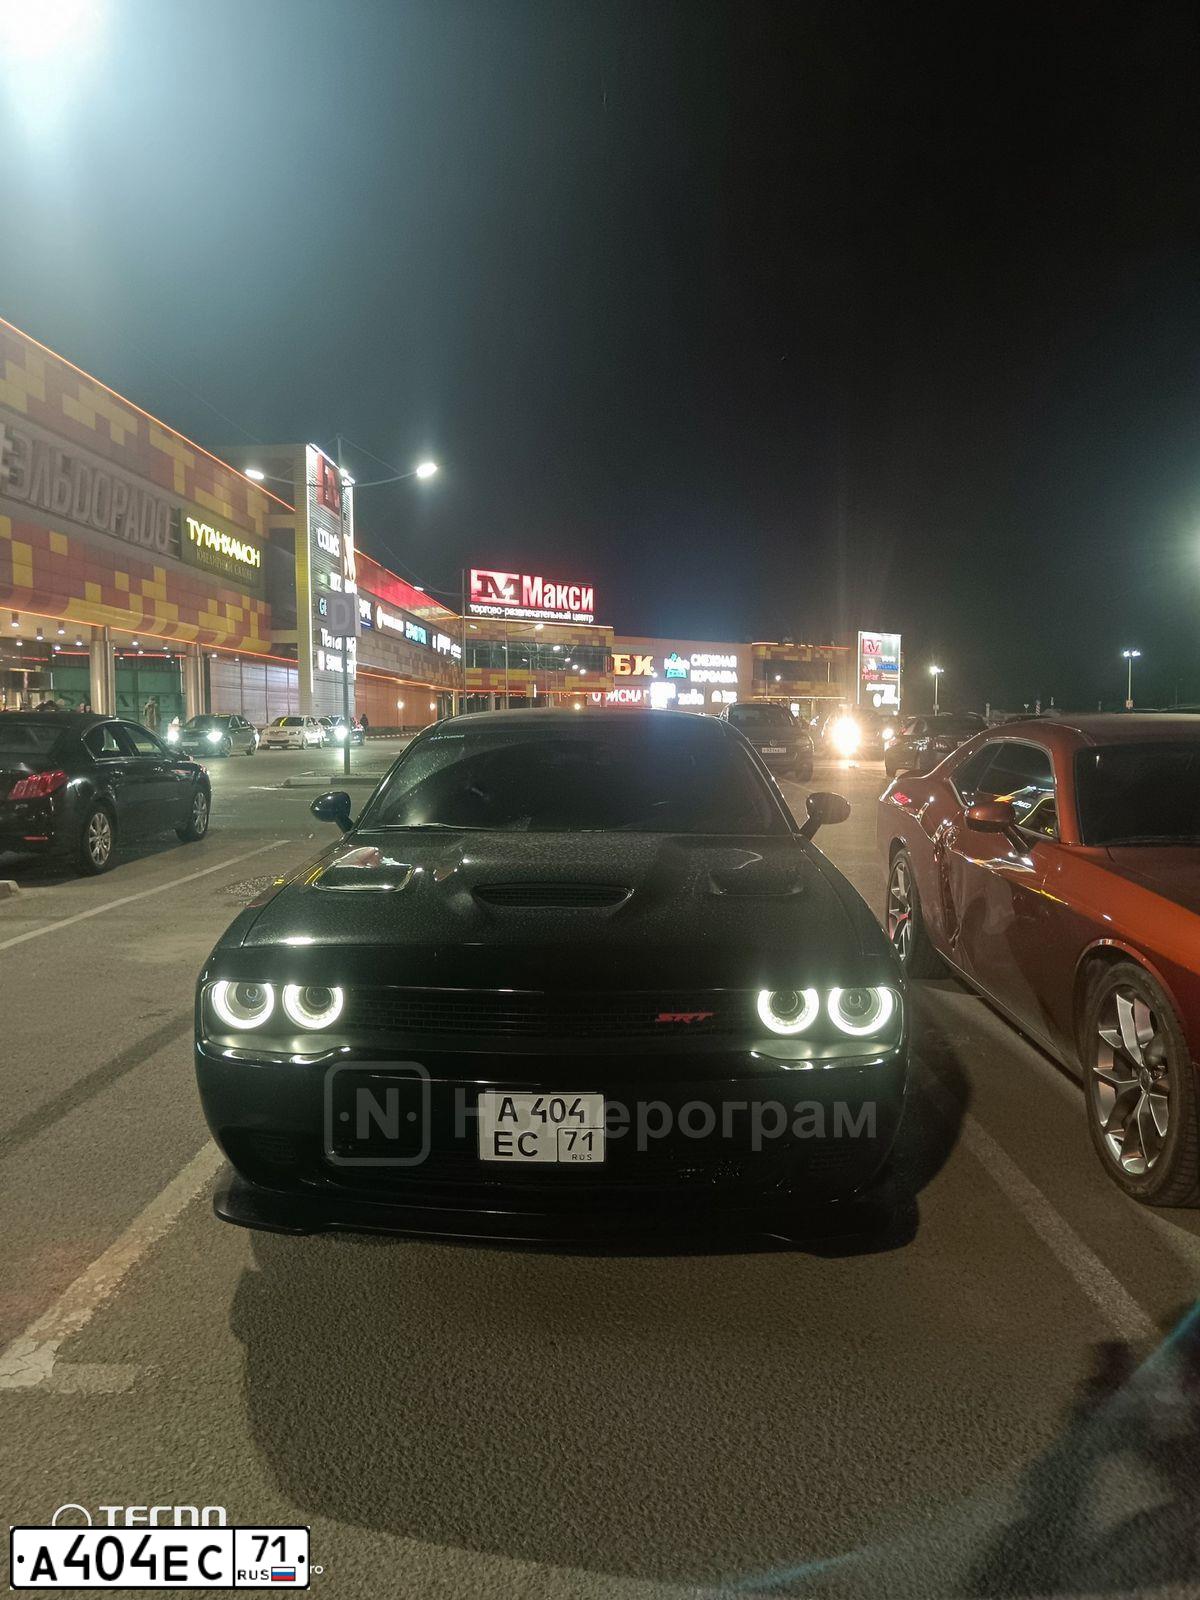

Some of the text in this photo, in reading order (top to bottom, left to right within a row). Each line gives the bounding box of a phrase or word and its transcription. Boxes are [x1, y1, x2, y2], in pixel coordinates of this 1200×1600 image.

[522, 575, 594, 612] Макси
[469, 605, 594, 623] торгово-развлекательный центр
[530, 1098, 585, 1123] 404
[494, 1131, 593, 1157] ЕС 71
[571, 1153, 592, 1161] RUS
